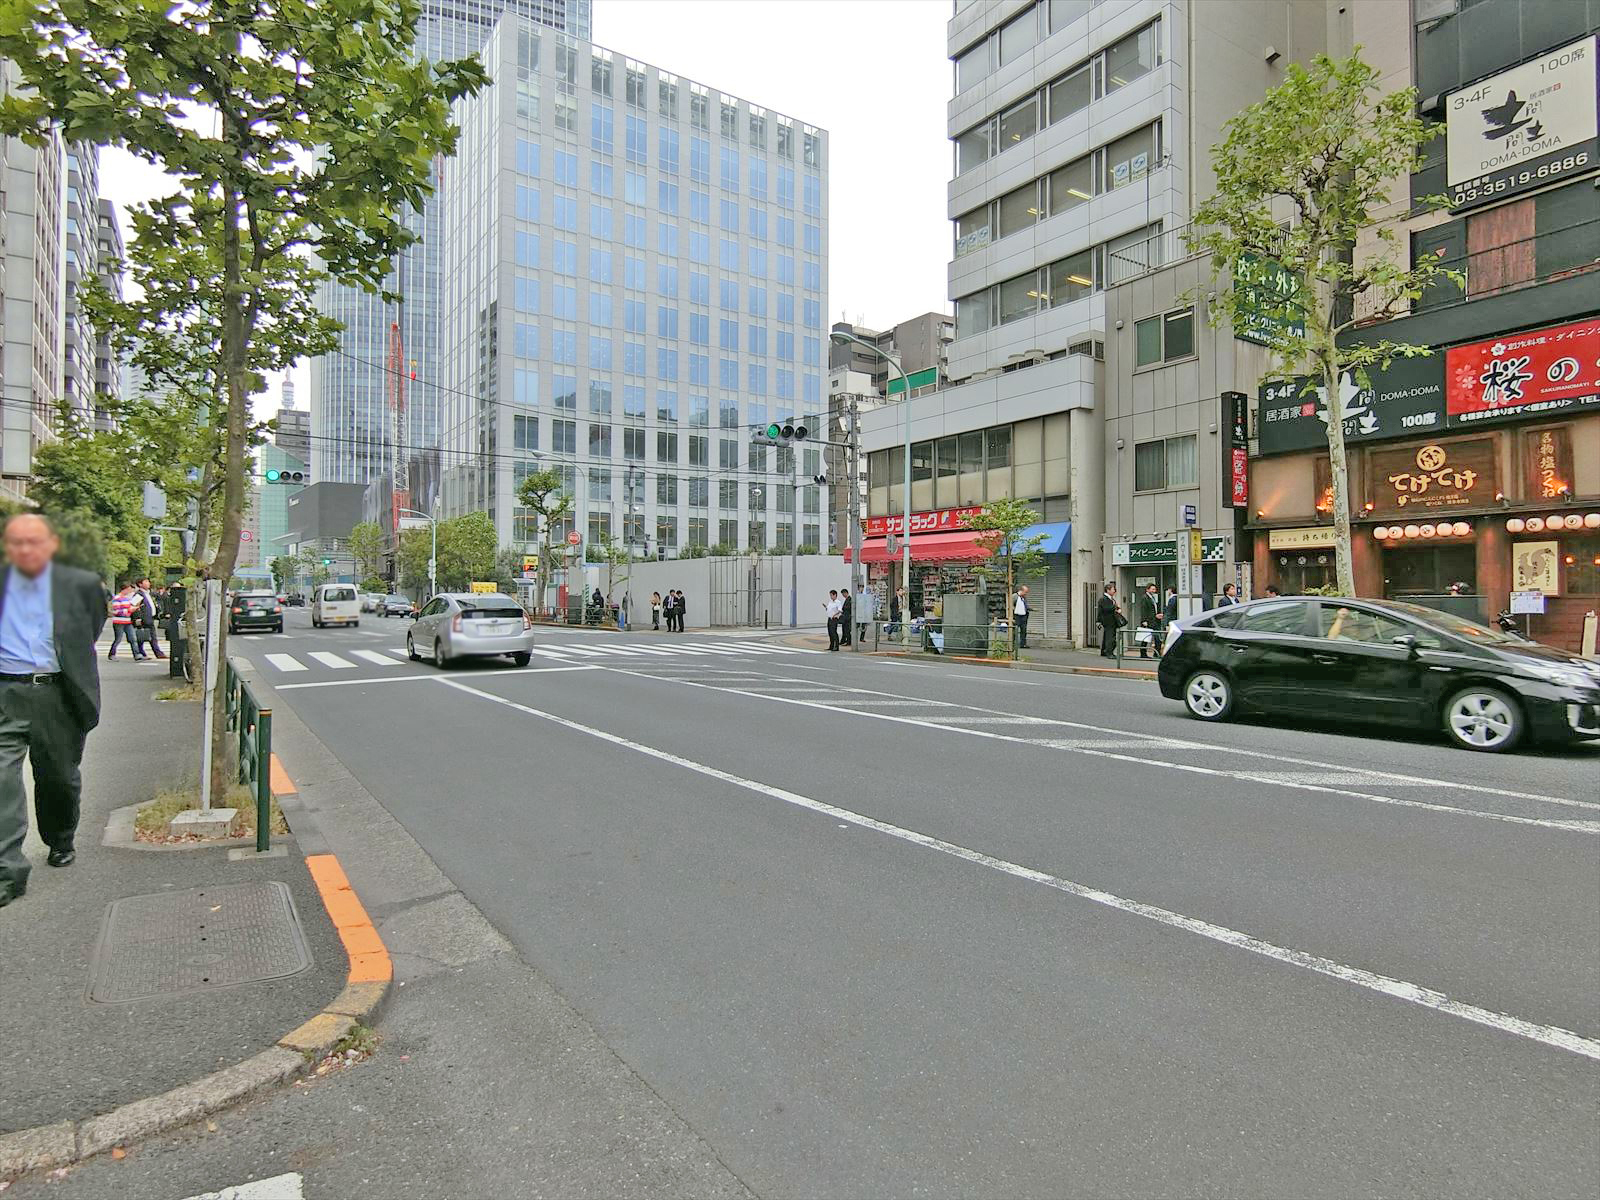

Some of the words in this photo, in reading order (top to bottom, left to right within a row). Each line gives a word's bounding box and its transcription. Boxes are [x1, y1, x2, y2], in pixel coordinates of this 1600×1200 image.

[1540, 47, 1585, 74] 100席
[1480, 135, 1562, 171] DOMA-DOMA
[1454, 152, 1588, 205] 03-3519-6886
[1388, 467, 1477, 494] てけてけ
[1540, 432, 1556, 498] 名物塩つくね
